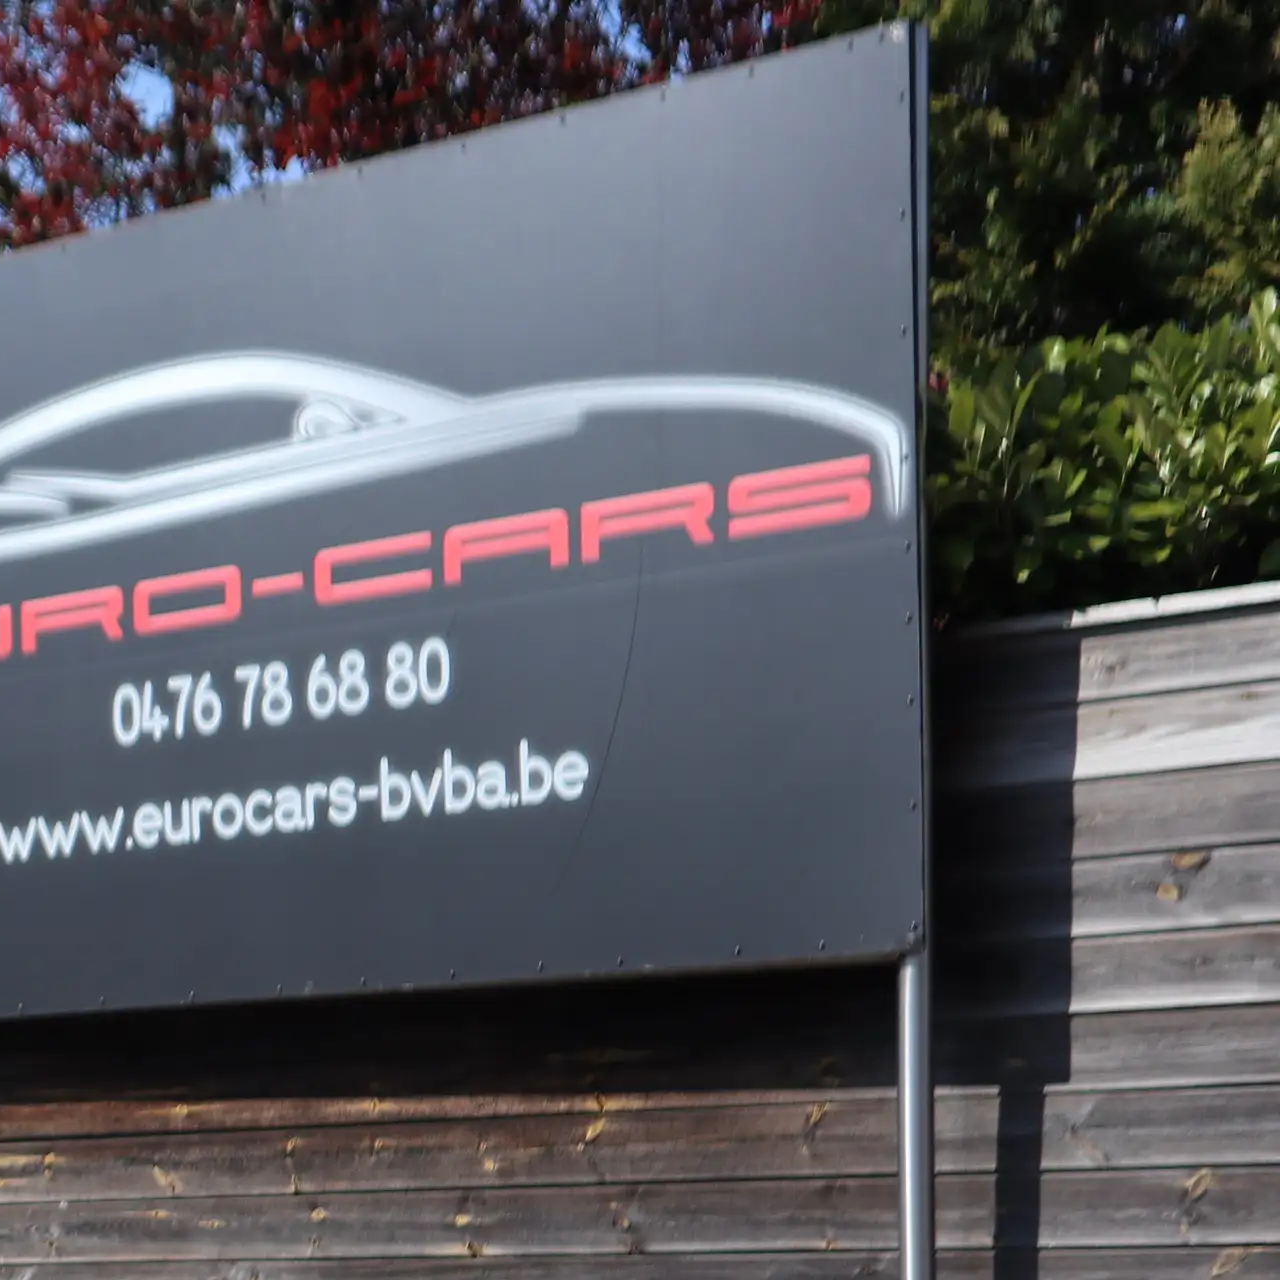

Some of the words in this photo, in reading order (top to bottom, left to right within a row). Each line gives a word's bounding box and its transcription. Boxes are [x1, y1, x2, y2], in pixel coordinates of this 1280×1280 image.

[112, 671, 223, 748] 0476
[234, 662, 293, 730] 78
[307, 649, 369, 719] 68
[384, 635, 452, 710] 80
